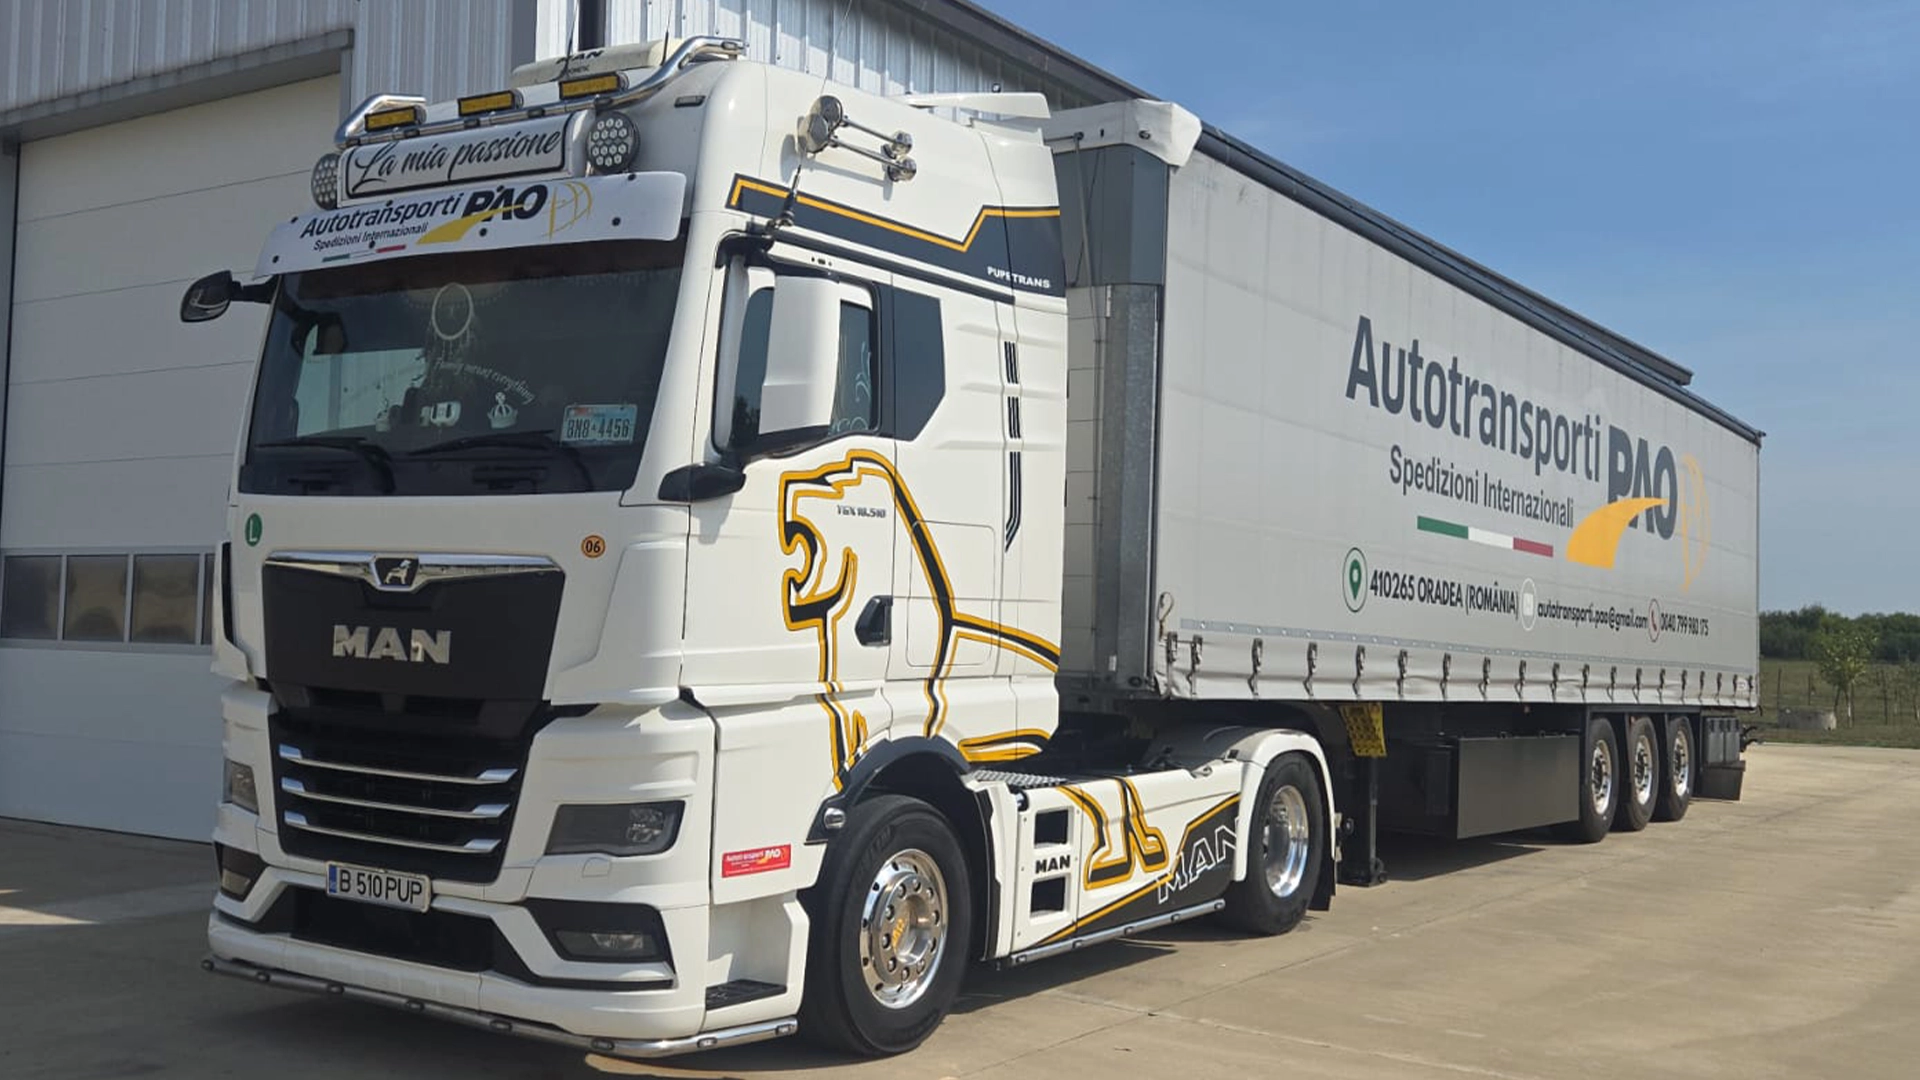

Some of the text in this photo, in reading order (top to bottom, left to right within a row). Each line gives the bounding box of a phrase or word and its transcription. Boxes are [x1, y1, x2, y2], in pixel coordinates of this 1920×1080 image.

[352, 131, 560, 193] La mia passione
[300, 184, 548, 239] Autotransporti PAO
[314, 223, 428, 252] Spedizioni Internazionali
[1346, 315, 1679, 540] Autotransporti PAO
[1390, 444, 1574, 528] Spedizioni Internazionali
[249, 518, 259, 543] L
[585, 539, 601, 553] 06
[1370, 569, 1519, 621] 410265 ORADEA (ROMÂNIA)
[332, 624, 452, 665] MAN
[1035, 854, 1071, 875] MAN
[340, 869, 423, 905] B 510 PUP
